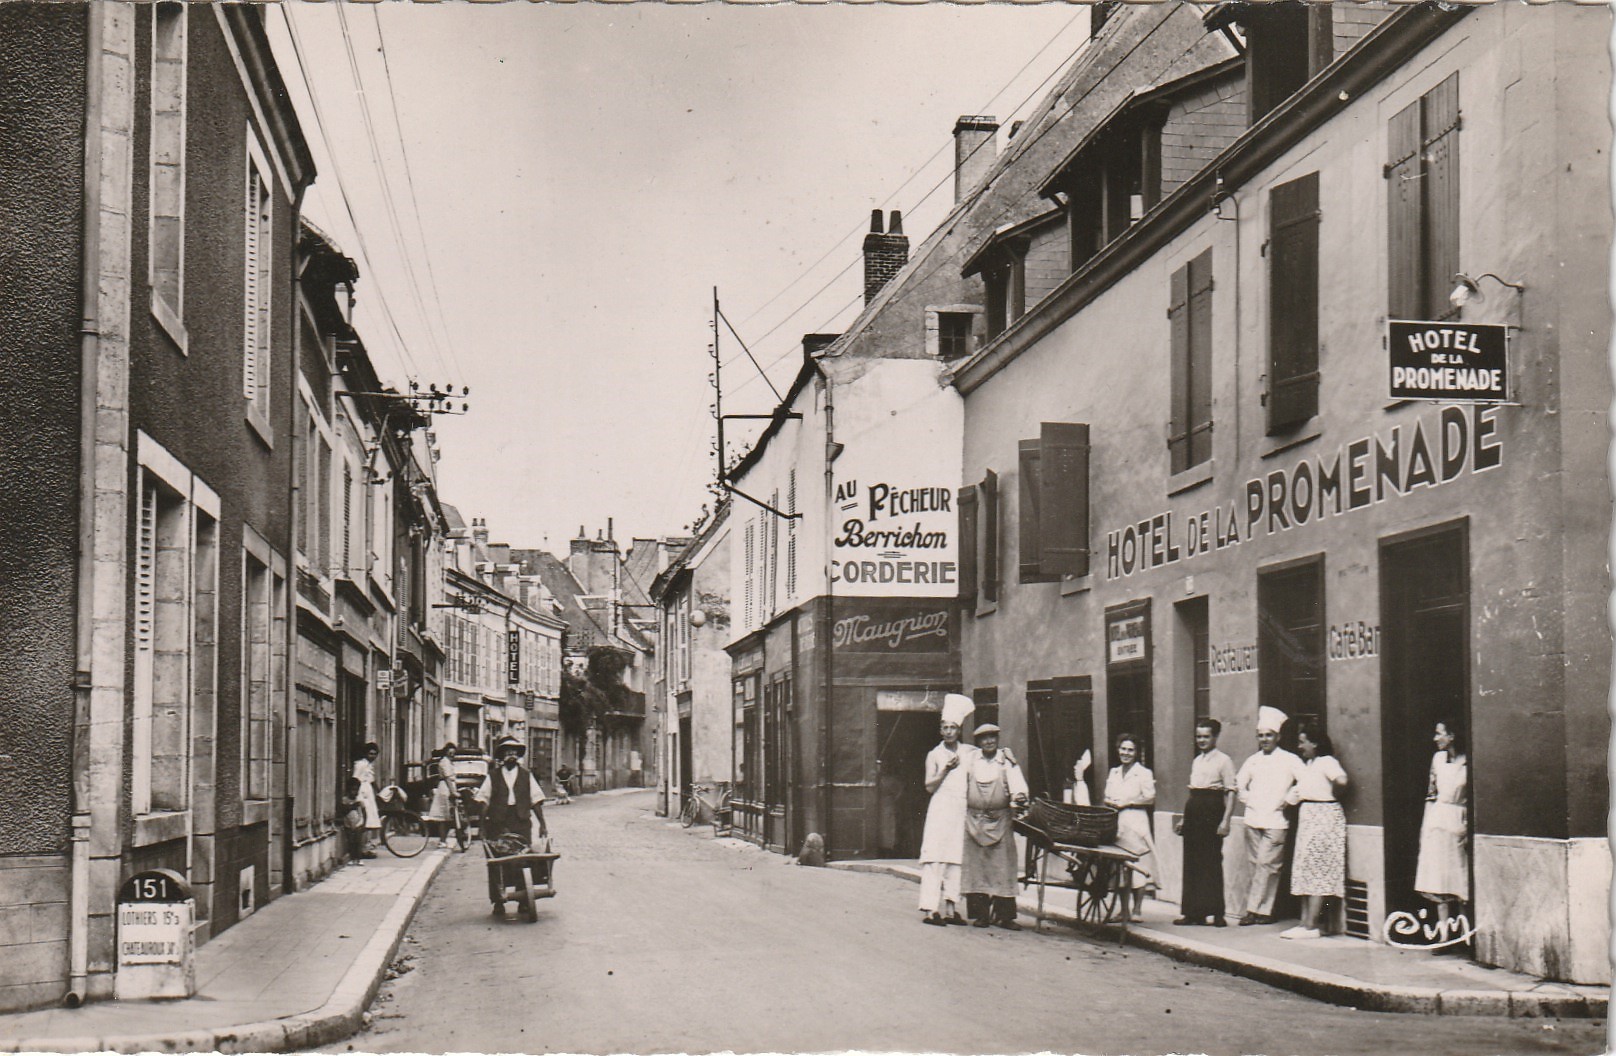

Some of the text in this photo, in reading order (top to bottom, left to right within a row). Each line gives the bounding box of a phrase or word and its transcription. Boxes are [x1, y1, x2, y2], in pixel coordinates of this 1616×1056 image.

[1407, 329, 1482, 354] HOTEL
[1430, 353, 1464, 365] DE LA
[1392, 366, 1502, 391] PROMENADE
[834, 480, 857, 504] AU
[1106, 404, 1504, 581] HOTEL DE LA PROMENADE
[834, 518, 948, 549] Berrichon
[825, 560, 957, 584] CORDERIE
[510, 633, 519, 681] HOTEL
[133, 878, 167, 899] 151
